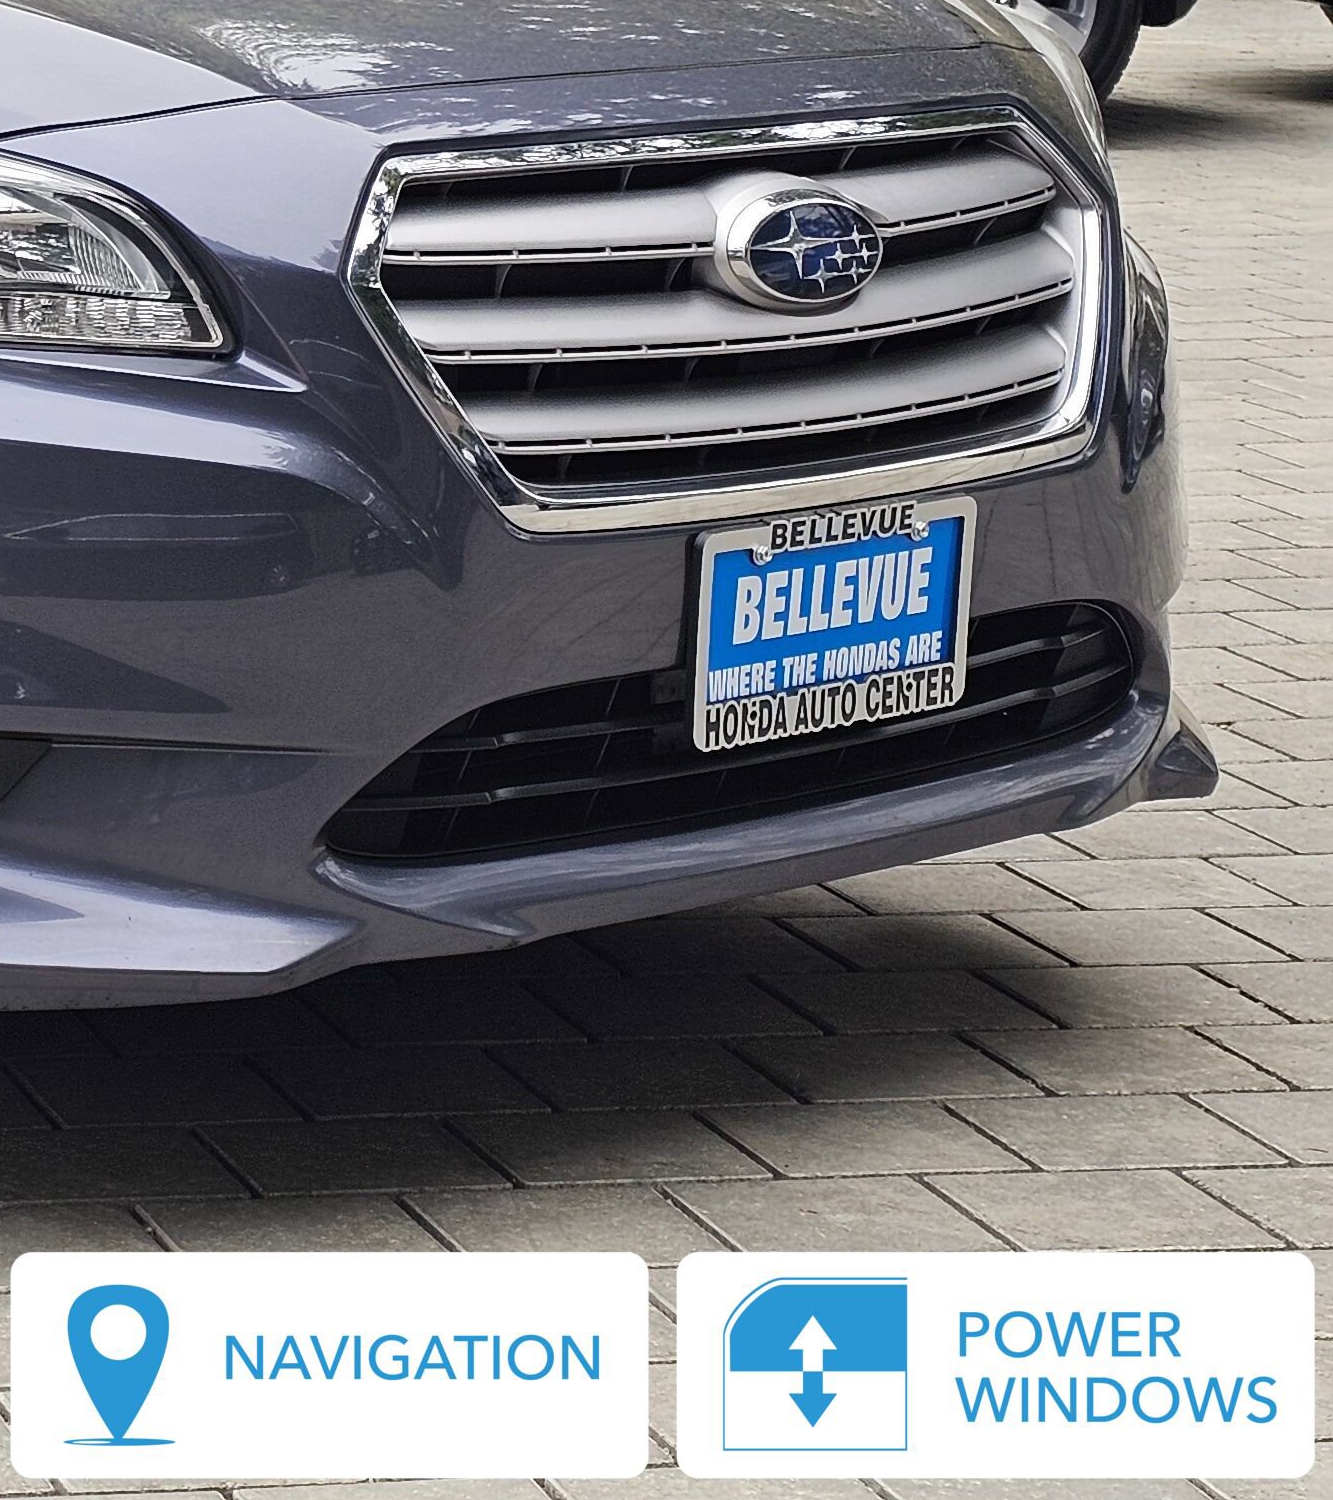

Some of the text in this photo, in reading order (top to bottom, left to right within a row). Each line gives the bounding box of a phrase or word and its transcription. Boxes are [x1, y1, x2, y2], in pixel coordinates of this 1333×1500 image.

[769, 502, 915, 550] BELLEVUE
[732, 547, 933, 645] BELLEVUE
[708, 631, 943, 703] WHERE THE HONDAS ARE
[704, 665, 954, 749] HONDA AUTO CENTER
